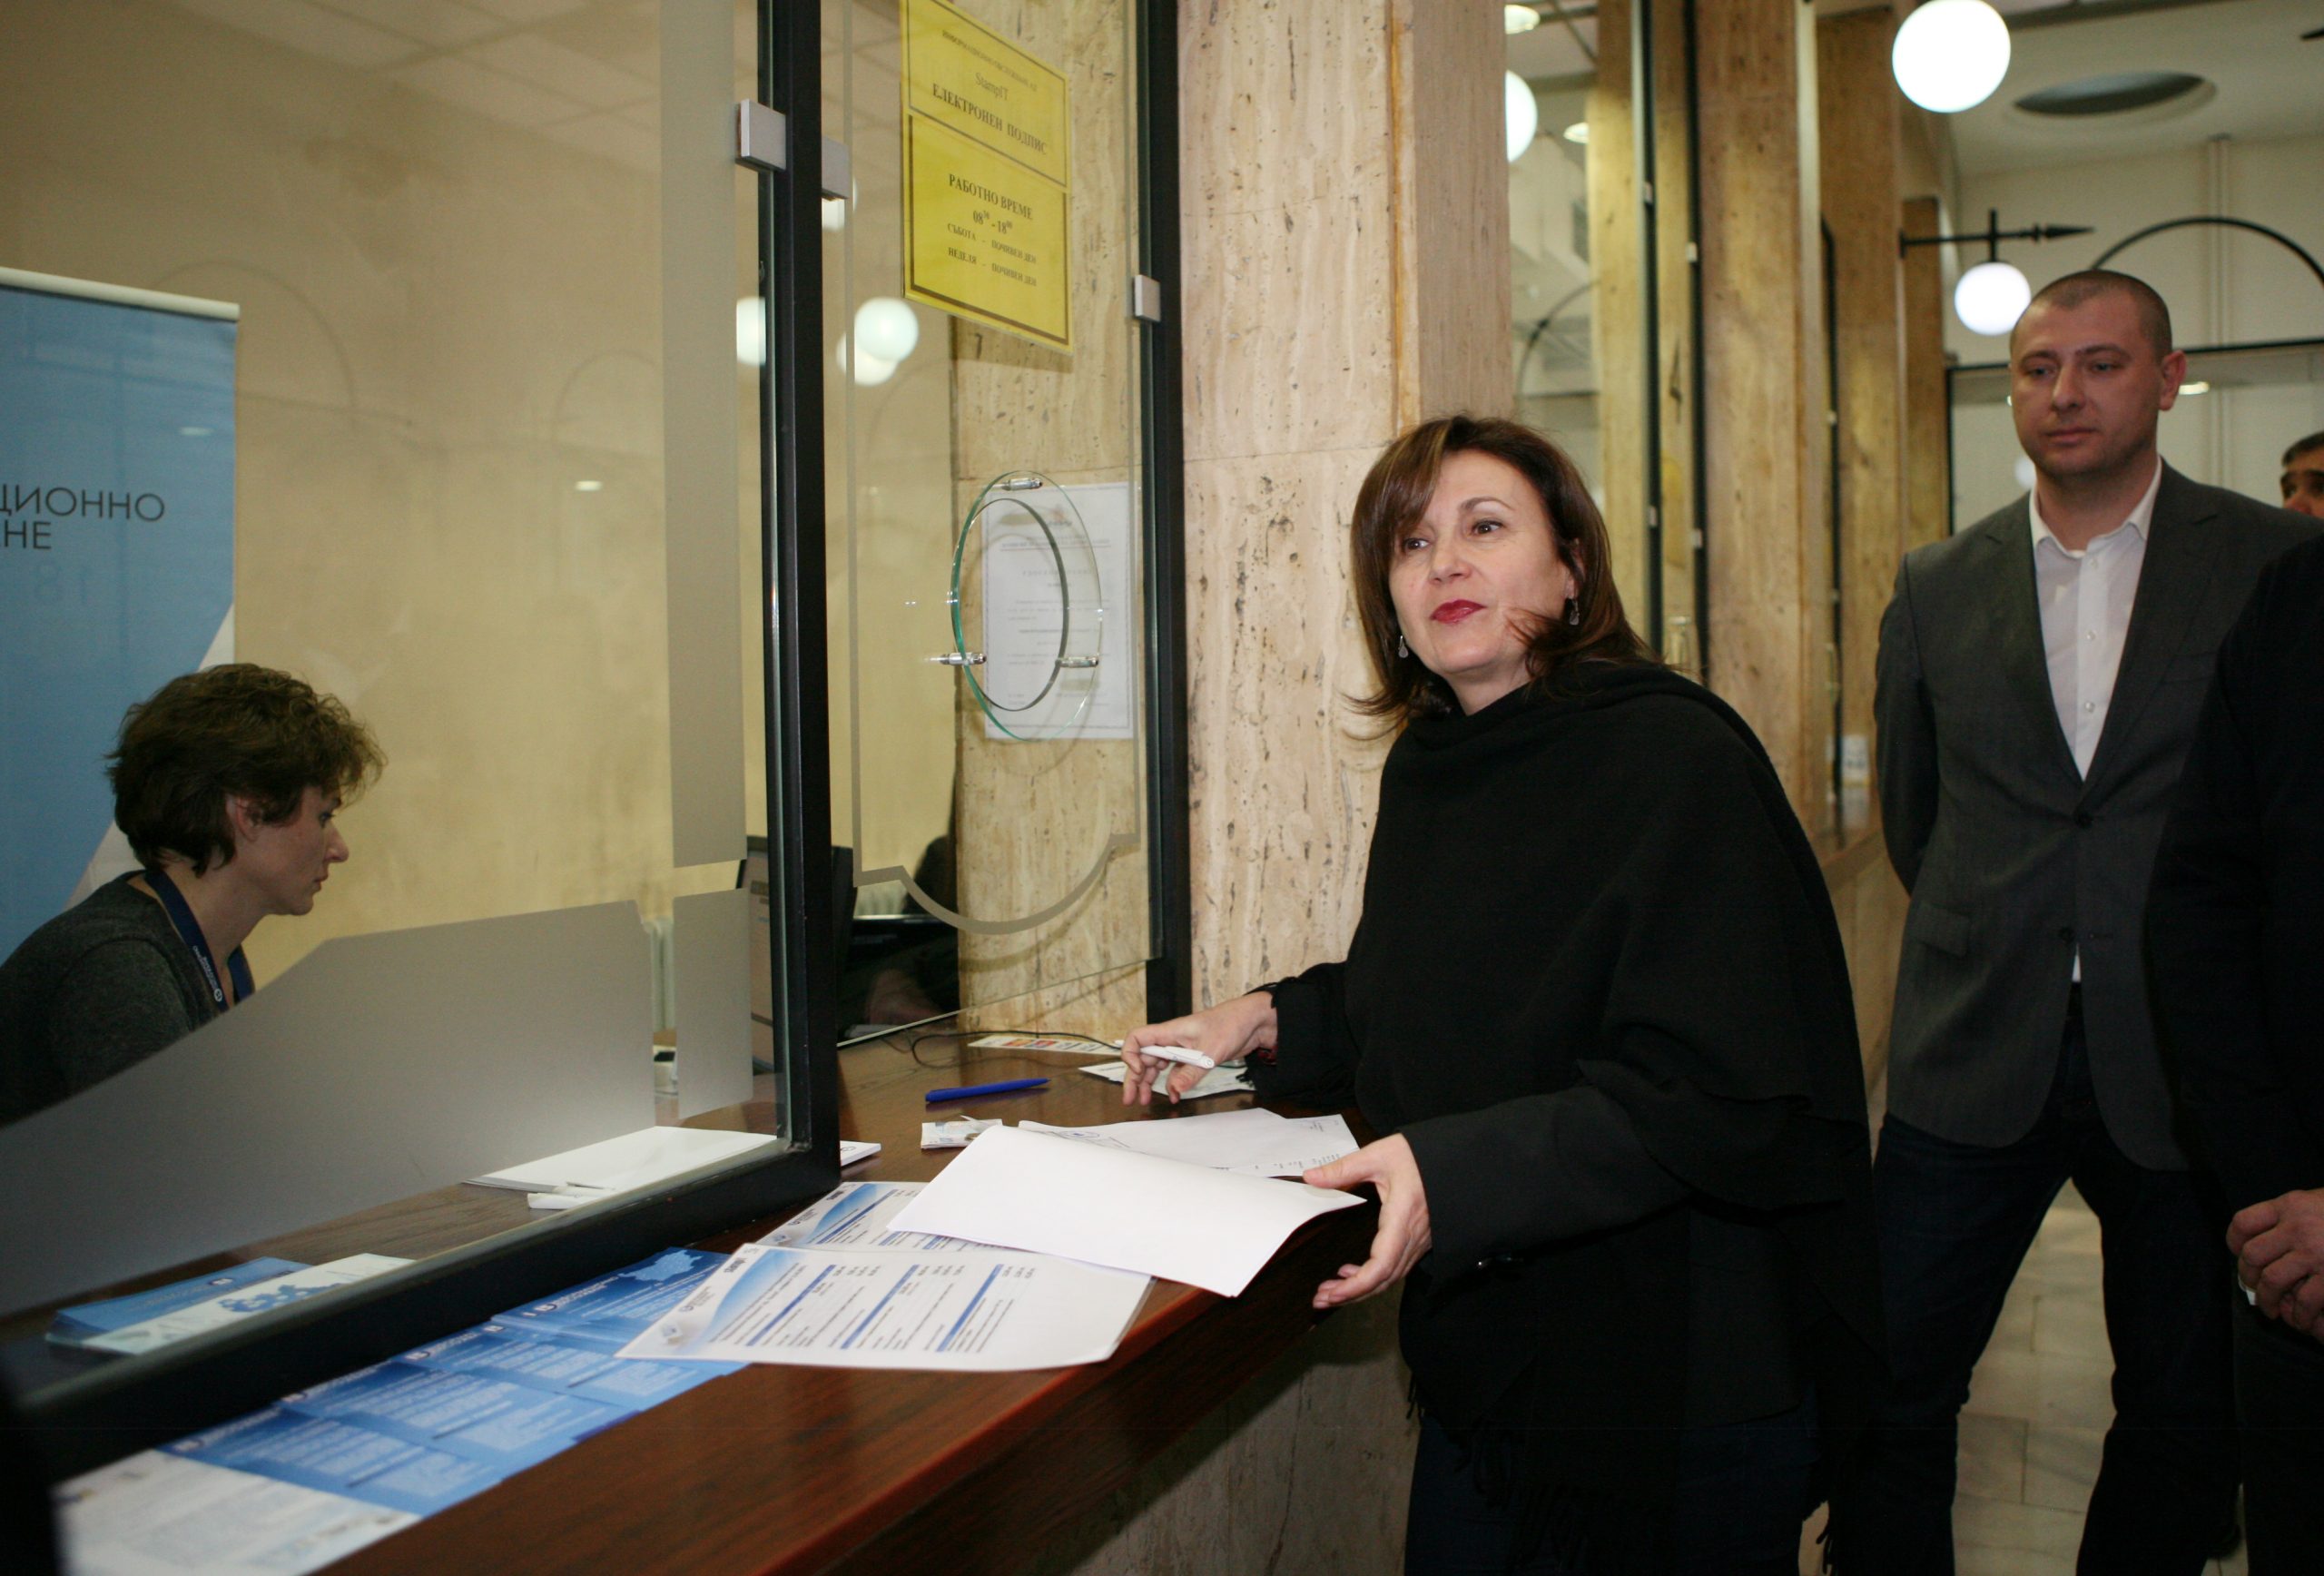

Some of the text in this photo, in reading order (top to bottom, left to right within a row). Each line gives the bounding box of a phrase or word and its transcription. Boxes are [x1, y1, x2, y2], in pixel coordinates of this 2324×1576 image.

[932, 83, 1047, 154] ЕЛЕКТРОНЕН ПОДПИС
[949, 173, 1033, 220] РАБОТНО ВРЕМЕ
[947, 223, 976, 241] СЪБОТА
[948, 247, 977, 265] НЕДЕЛЯ
